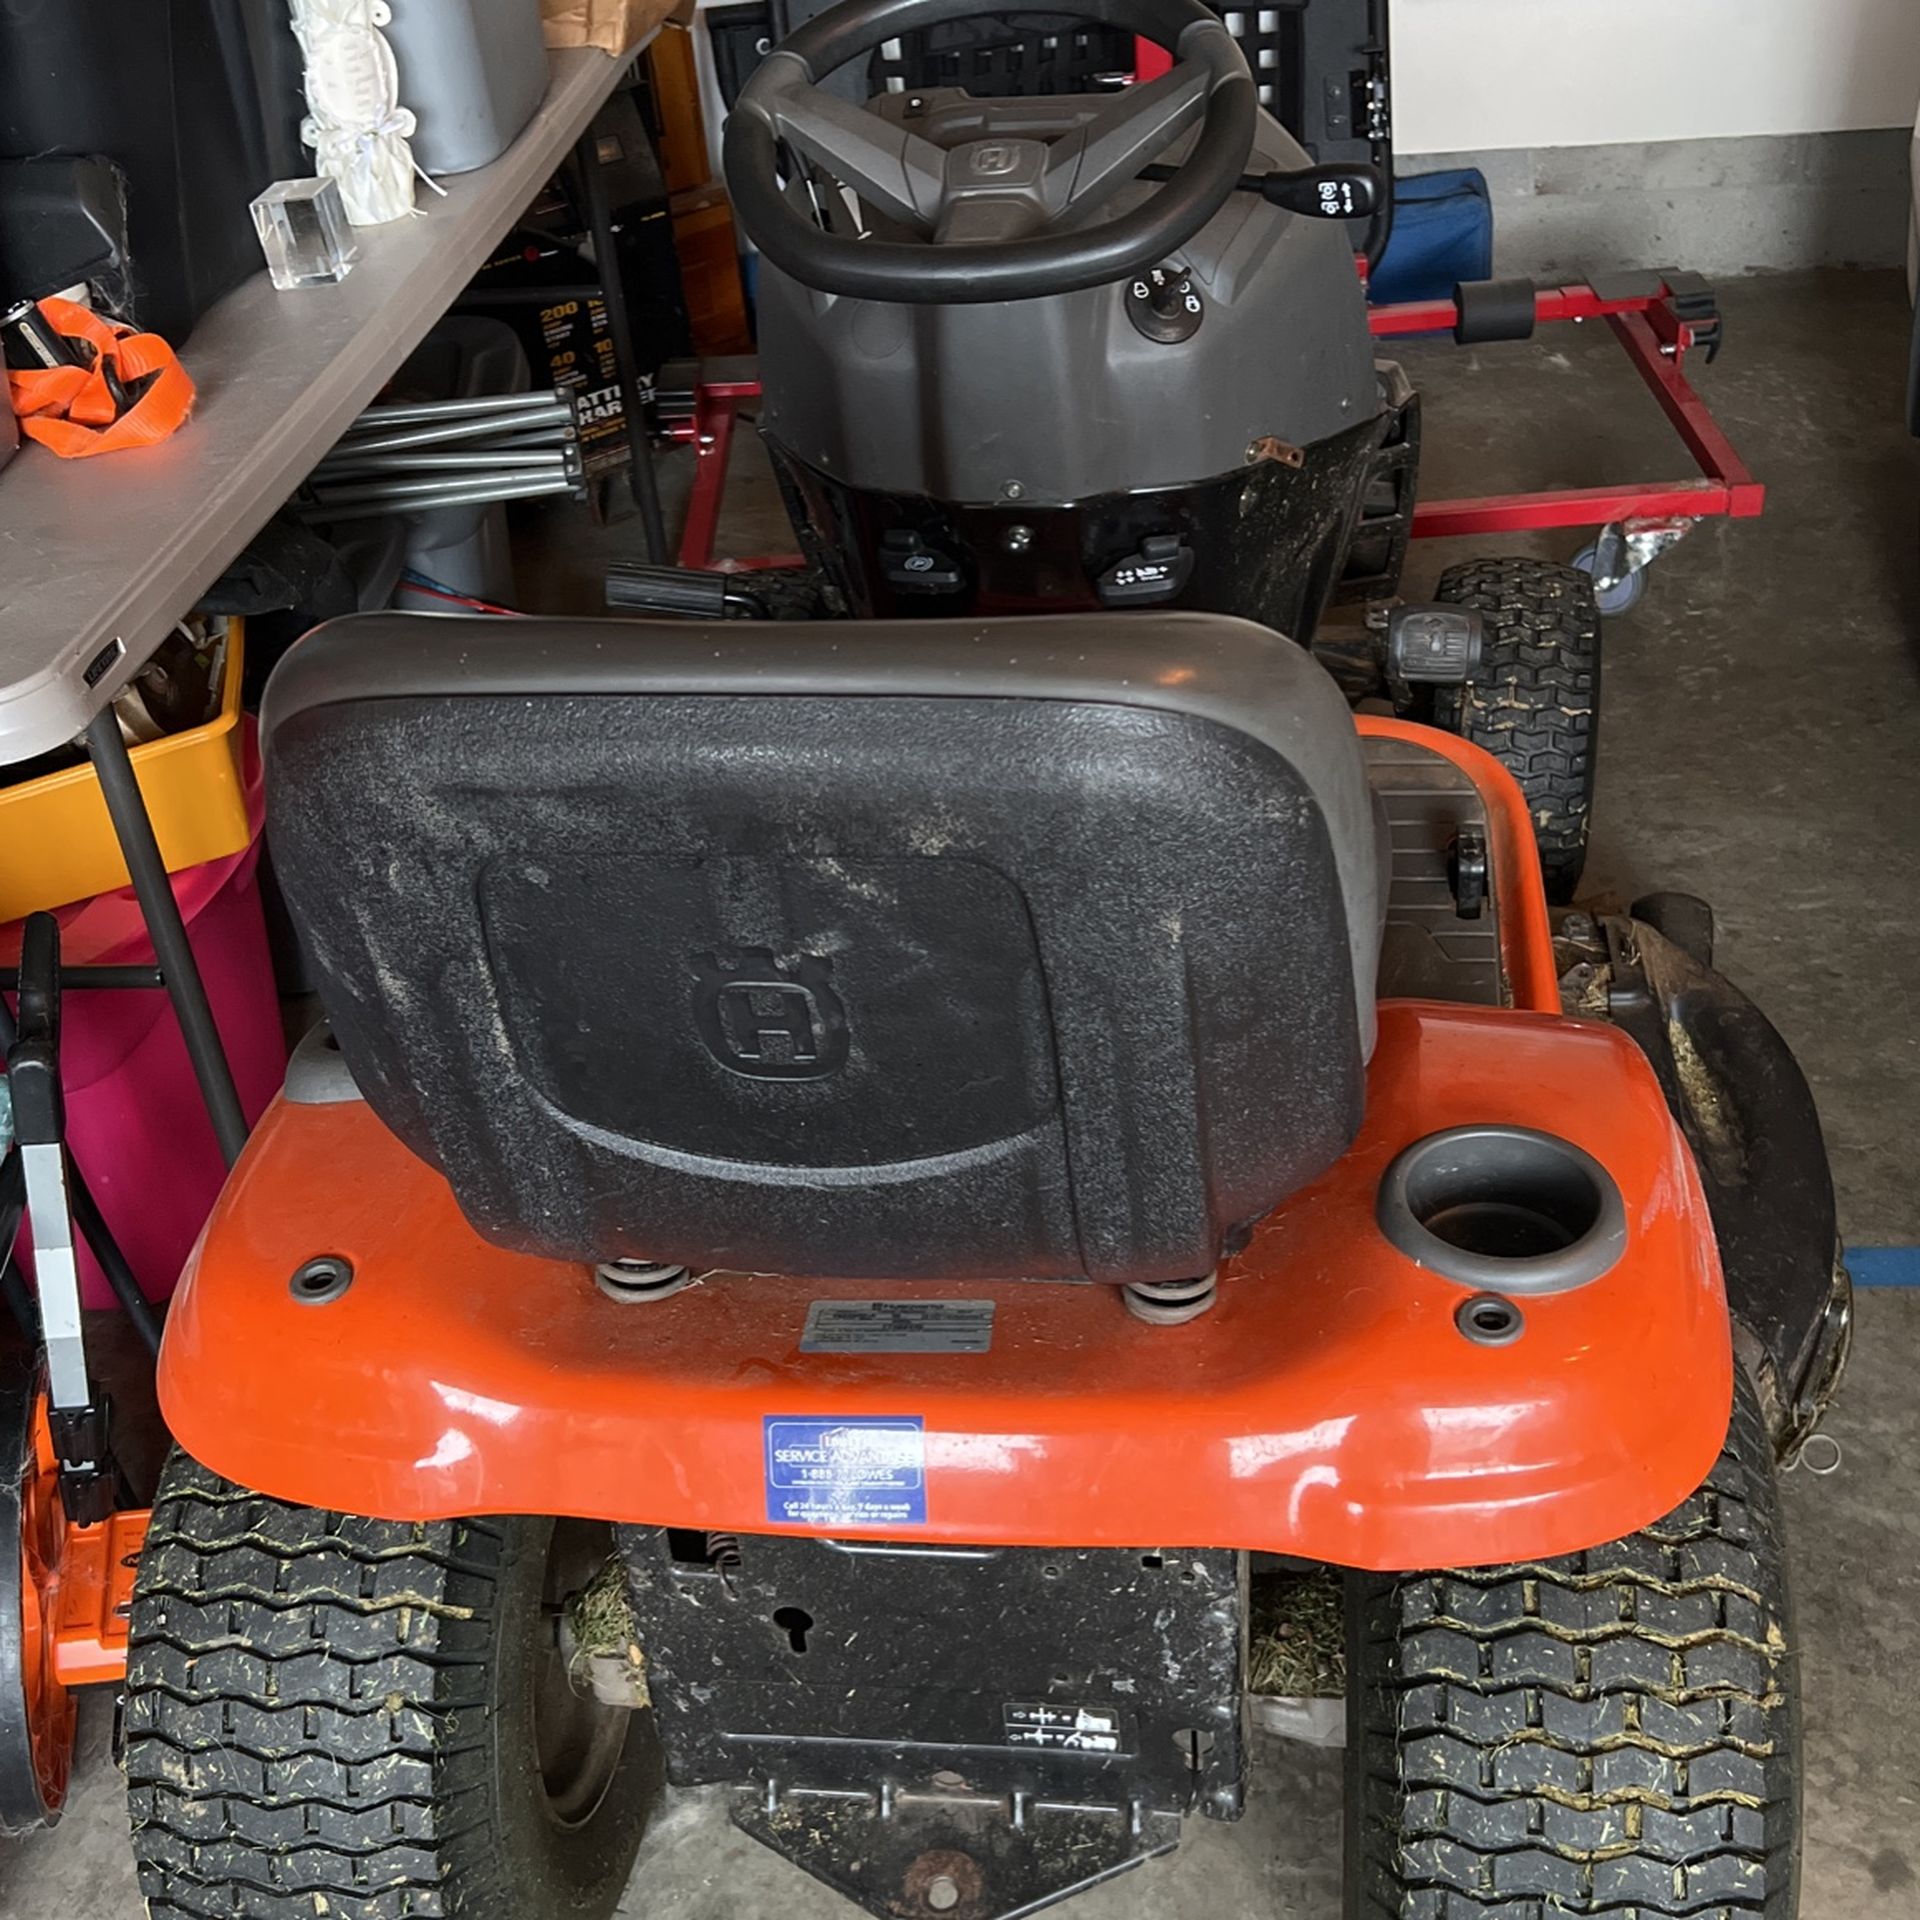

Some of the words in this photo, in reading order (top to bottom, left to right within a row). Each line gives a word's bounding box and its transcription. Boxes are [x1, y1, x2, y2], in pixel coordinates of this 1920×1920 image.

[539, 300, 578, 322] 200
[550, 351, 576, 367] 40
[774, 1448, 828, 1463] SERVICE
